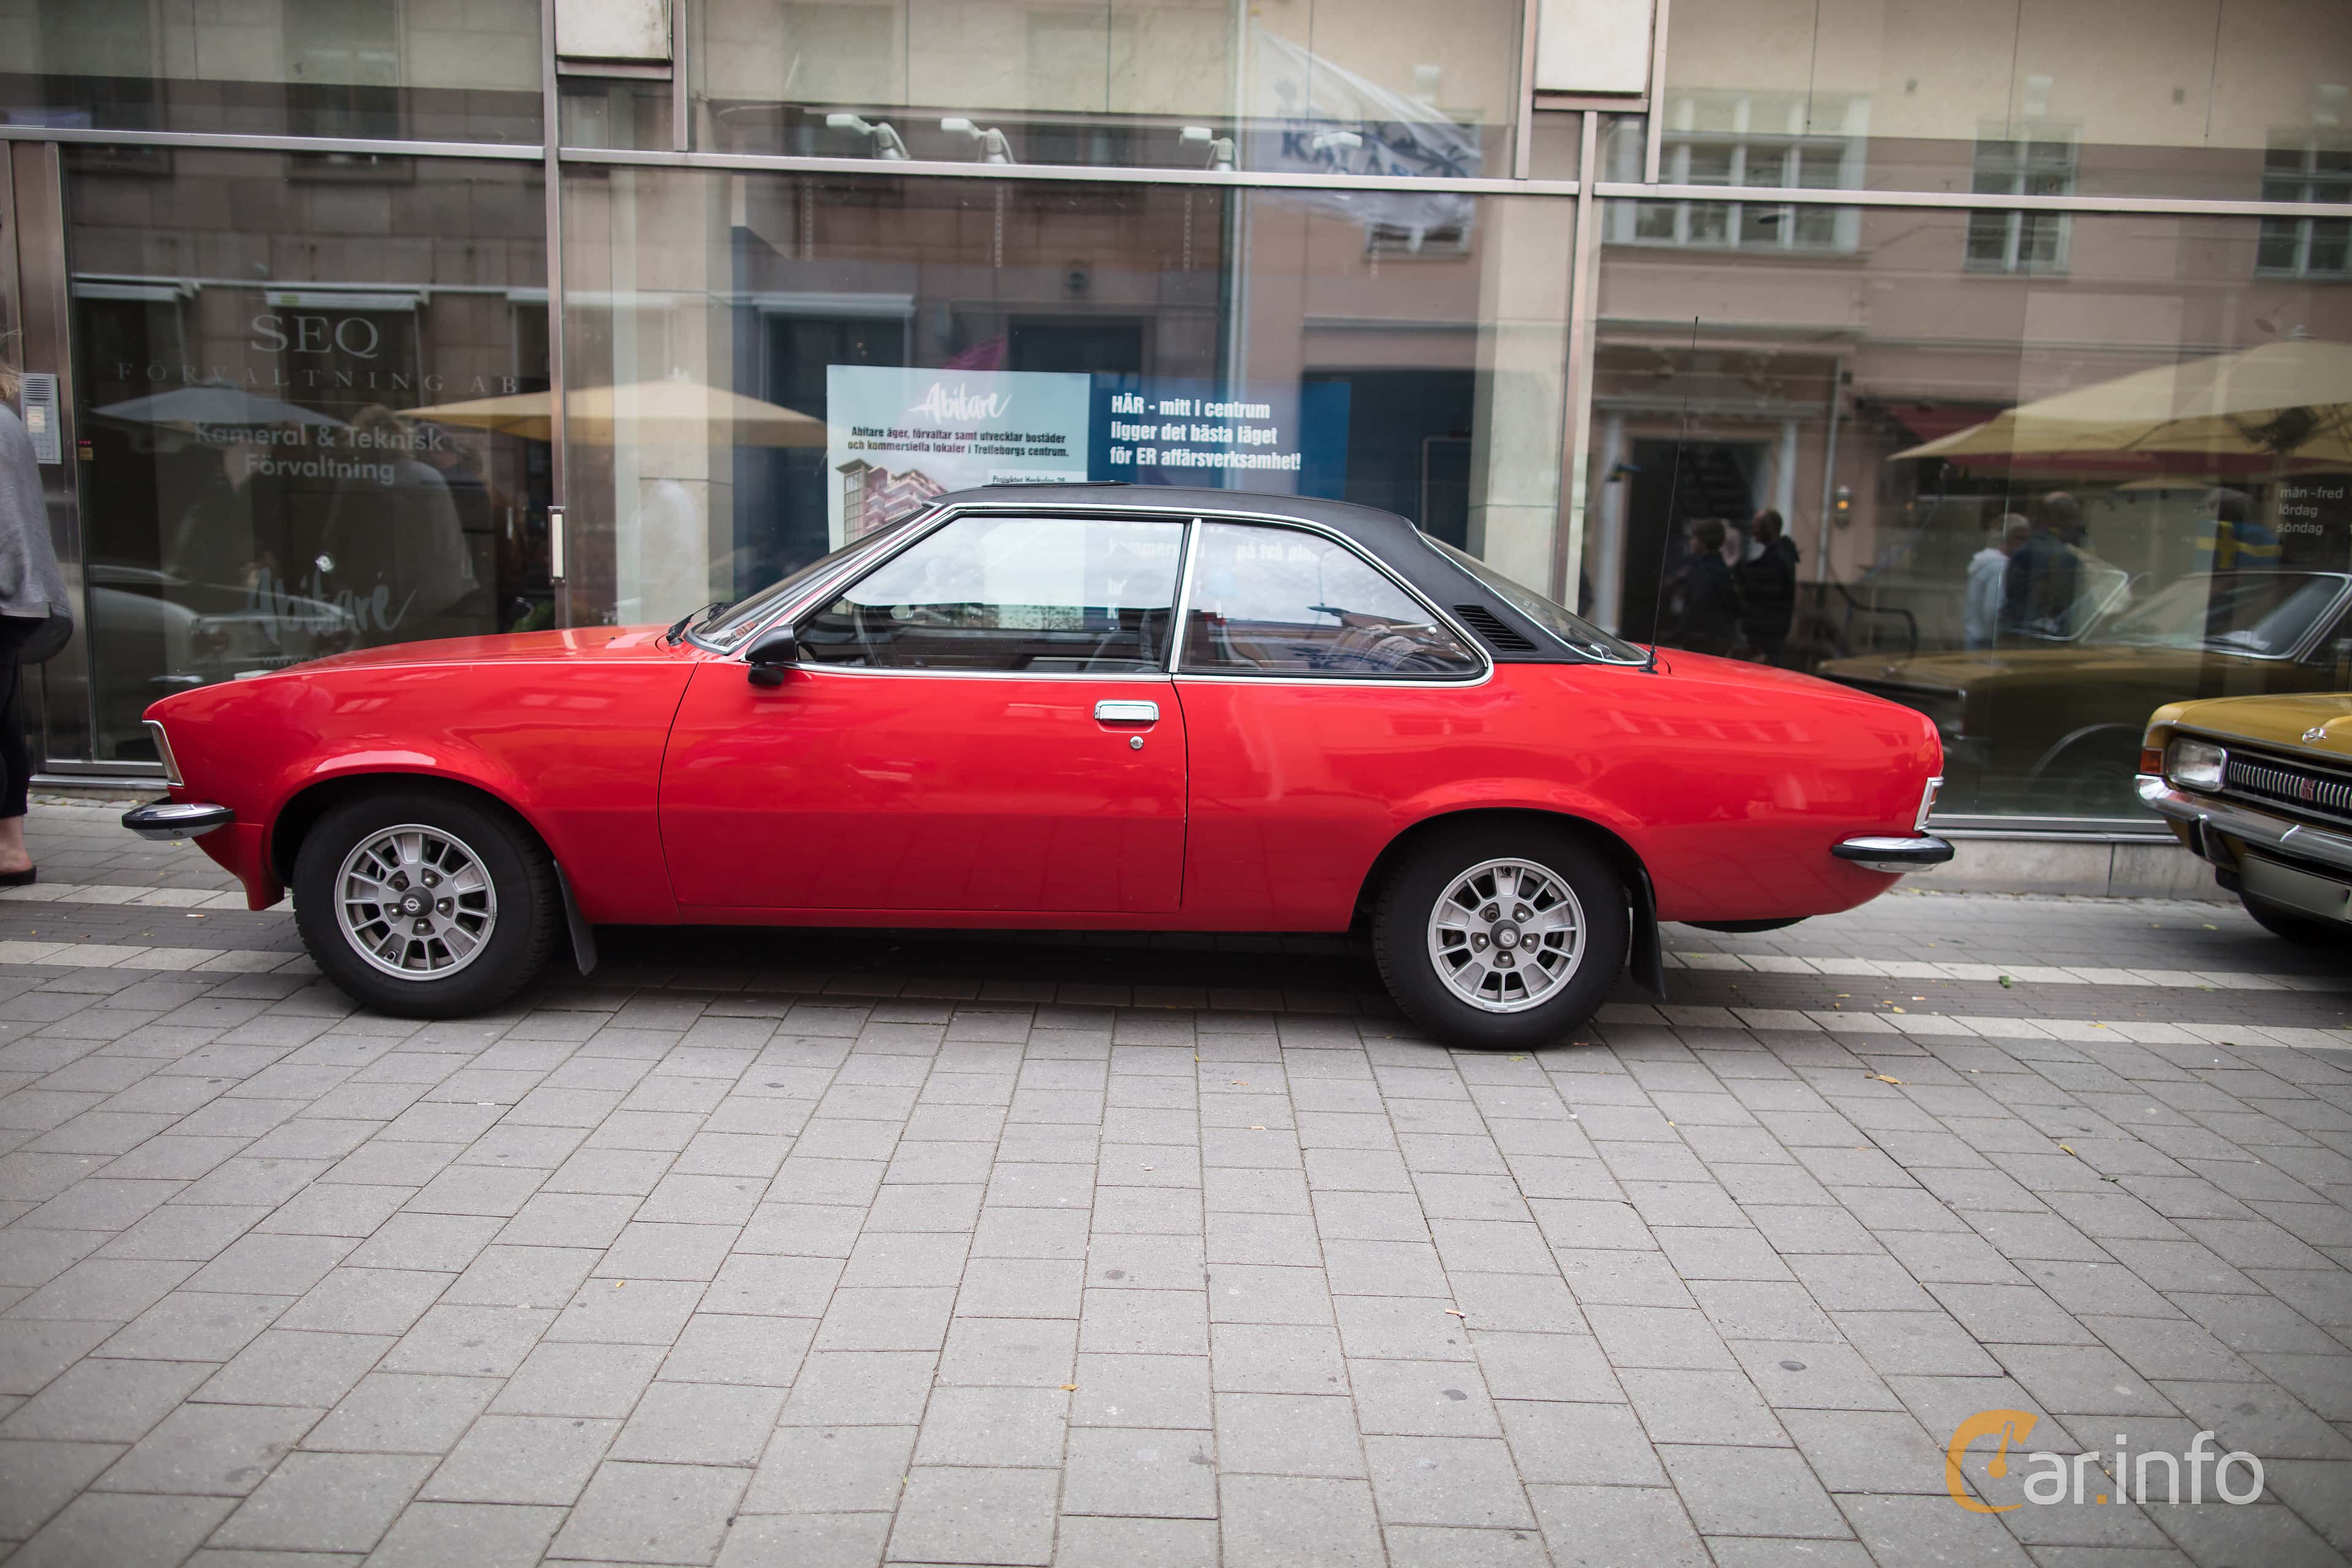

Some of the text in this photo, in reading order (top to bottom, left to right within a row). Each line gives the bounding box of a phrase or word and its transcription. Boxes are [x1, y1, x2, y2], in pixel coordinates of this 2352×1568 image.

[251, 314, 379, 358] SEQ
[907, 382, 1012, 424] Abitare
[1111, 393, 1144, 414] HÄR
[1159, 398, 1191, 417] mitt
[1194, 399, 1200, 417] i
[1204, 401, 1270, 419] centrum
[195, 423, 445, 451] Kameral & Teknisk
[851, 426, 1066, 443] Abitare äger, förvaltar samt utvecklar bostäder
[1110, 421, 1278, 446] ligger det bästa läget
[848, 440, 1069, 457] och kommersiella lokaler i Trelleborgs centrum.
[1110, 446, 1302, 470] för ER affärsverksamhet!
[246, 453, 396, 485] Förvaltning
[2280, 486, 2307, 499] mån
[2278, 503, 2318, 518] lördag
[2276, 521, 2324, 536] söndag
